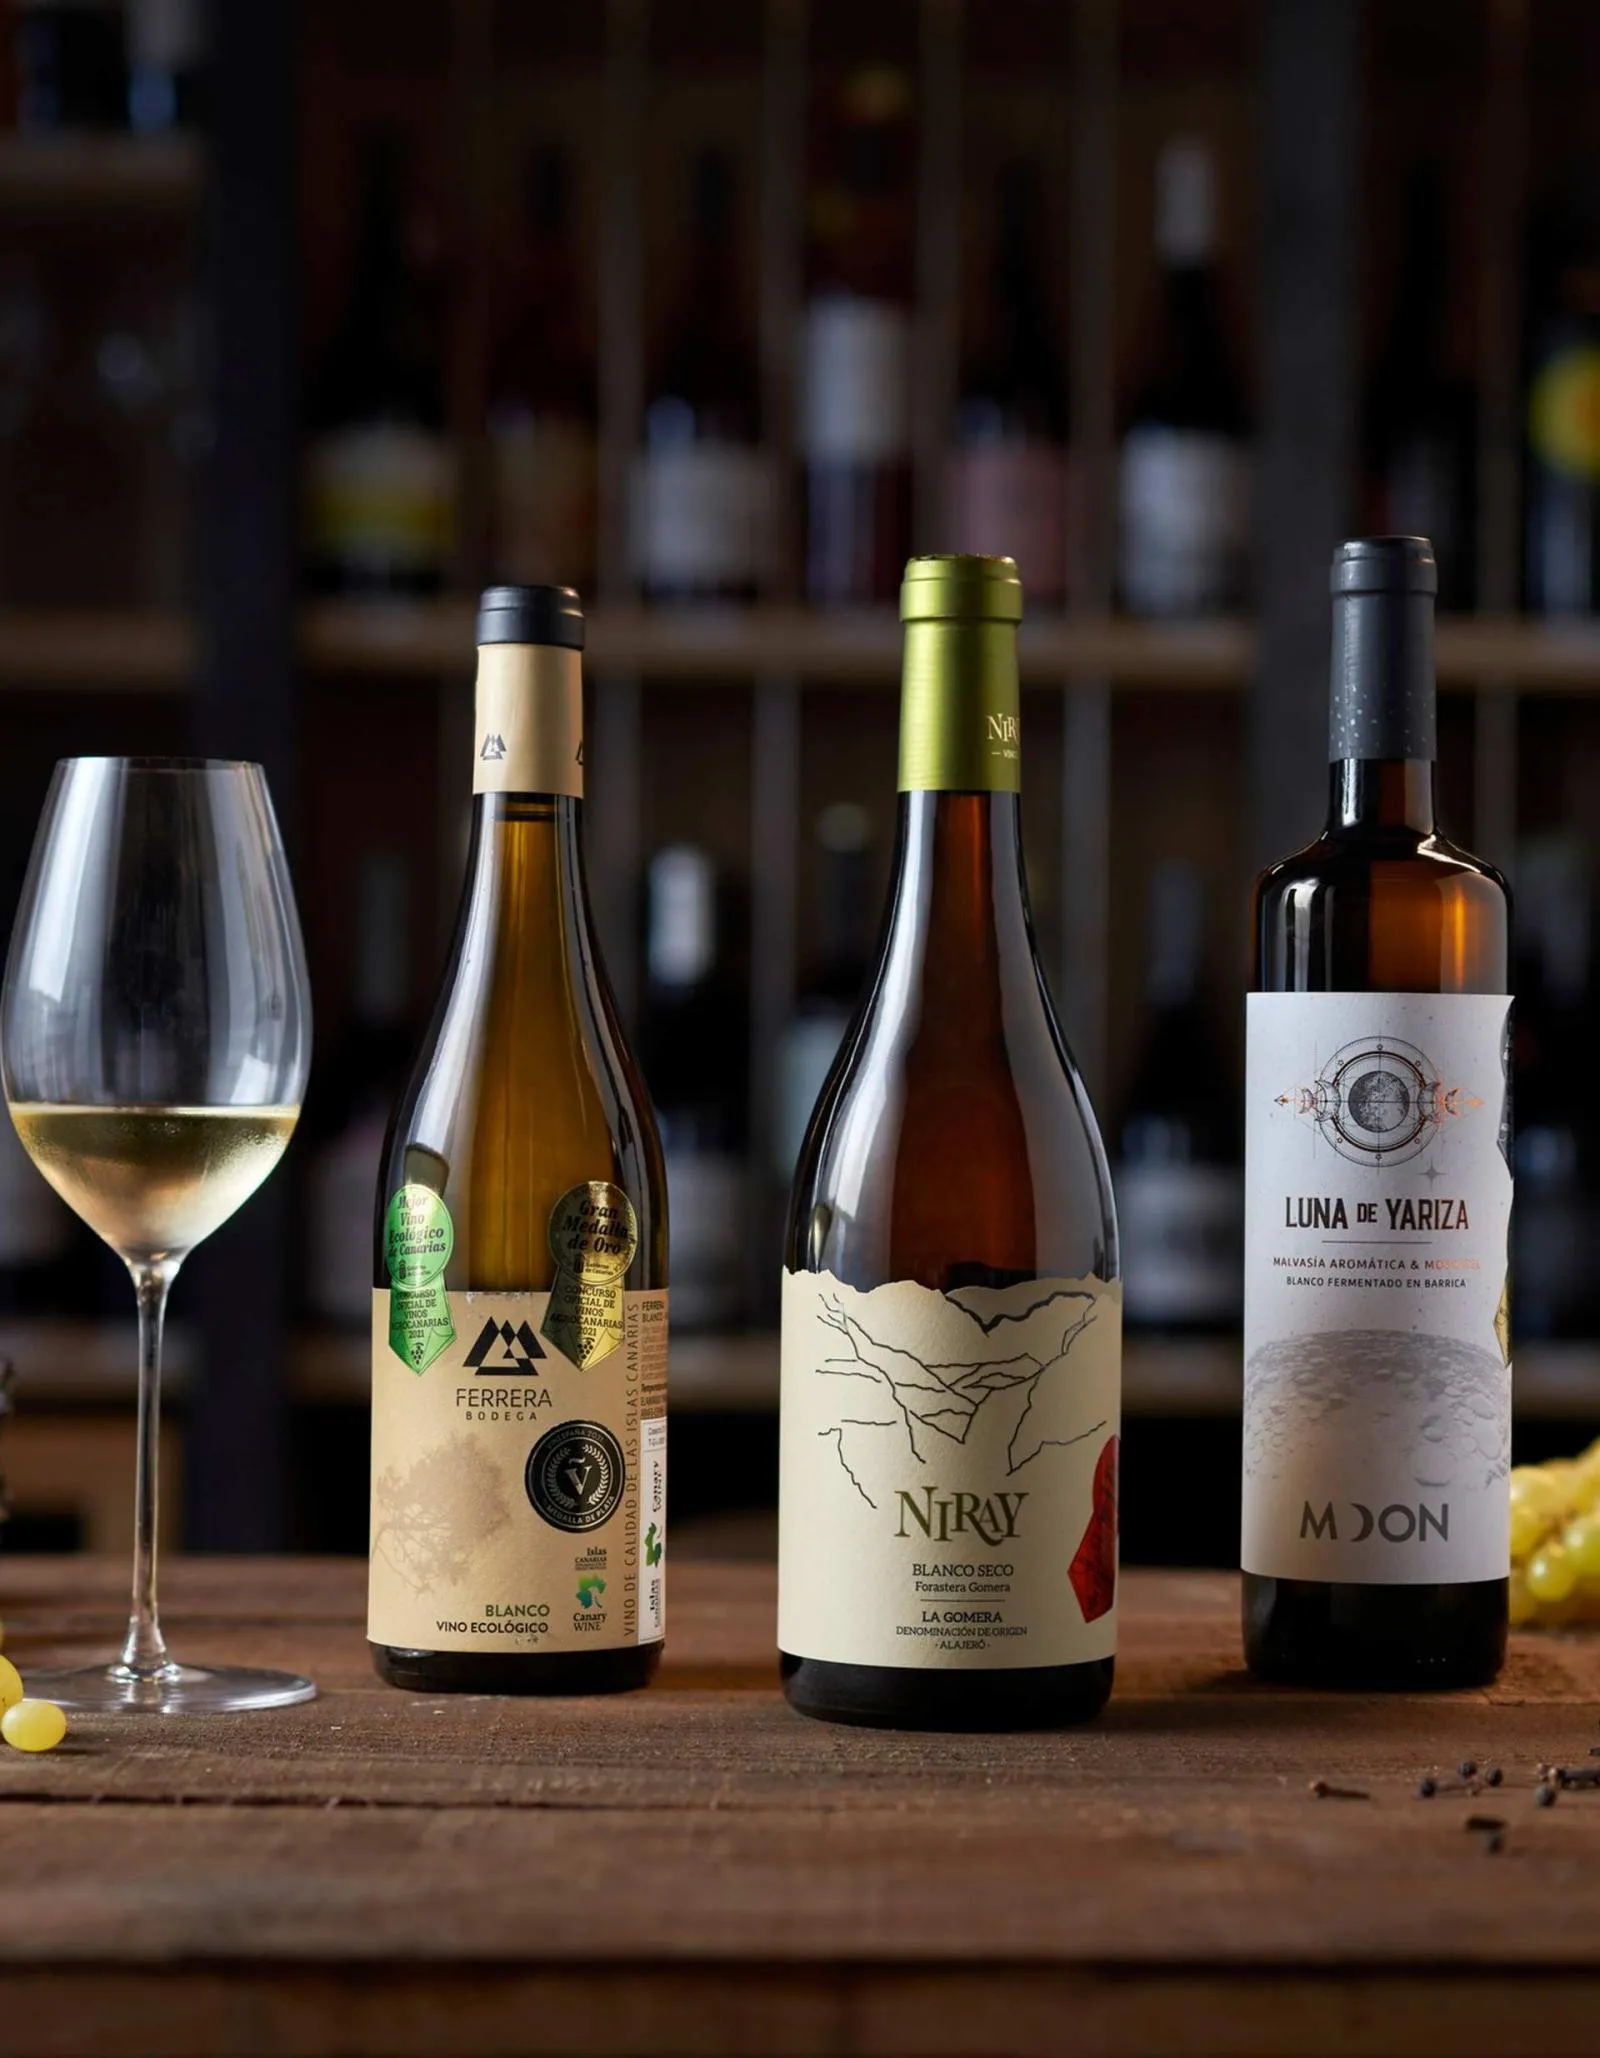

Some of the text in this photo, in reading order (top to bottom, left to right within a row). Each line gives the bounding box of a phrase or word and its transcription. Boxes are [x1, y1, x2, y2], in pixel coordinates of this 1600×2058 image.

[985, 713, 1020, 745] NIR
[398, 1194, 428, 1212] Mejor
[580, 1201, 618, 1219] Gran
[1285, 1196, 1469, 1230] LUNA DE YARIZA
[400, 1212, 425, 1226] Vino
[563, 1215, 628, 1238] Medalla
[389, 1226, 444, 1243] Ecológico
[400, 1241, 446, 1256] Canarias
[568, 1234, 620, 1255] de Oro
[1273, 1255, 1480, 1271] MALVASÍA AROMÁTICA & MOSEL
[1286, 1276, 1466, 1288] BLANCO FERMENTADO EN BARRICA
[565, 1285, 616, 1299] CONCURSO
[425, 1299, 437, 1308] DE
[603, 1299, 615, 1309] DE
[404, 1310, 428, 1319] VINOS
[575, 1306, 605, 1317] VINOS
[408, 1329, 425, 1339] 2021
[578, 1327, 597, 1337] 2021
[456, 1388, 552, 1408] FERRERA
[465, 1411, 537, 1421] BODEGA
[623, 1303, 639, 1636] VINO DE CALIDAD DE LAS ISLAS CANARIAS
[585, 1515, 596, 1524] DE
[894, 1486, 1030, 1546] NIRAY
[587, 1547, 607, 1556] Islas
[912, 1564, 1014, 1577] BLANCO SECO
[915, 1581, 1011, 1594] Forastera Gomera
[485, 1604, 550, 1617] BLANCO
[922, 1611, 1003, 1623] LA GOMERA
[573, 1612, 607, 1623] Canary
[436, 1620, 549, 1633] VINO ECOLÓGICO
[573, 1622, 602, 1632] WINE
[896, 1625, 1028, 1637] DENOMINACIÓN DE ORIGEN
[939, 1638, 986, 1650] ALAJERÓ
